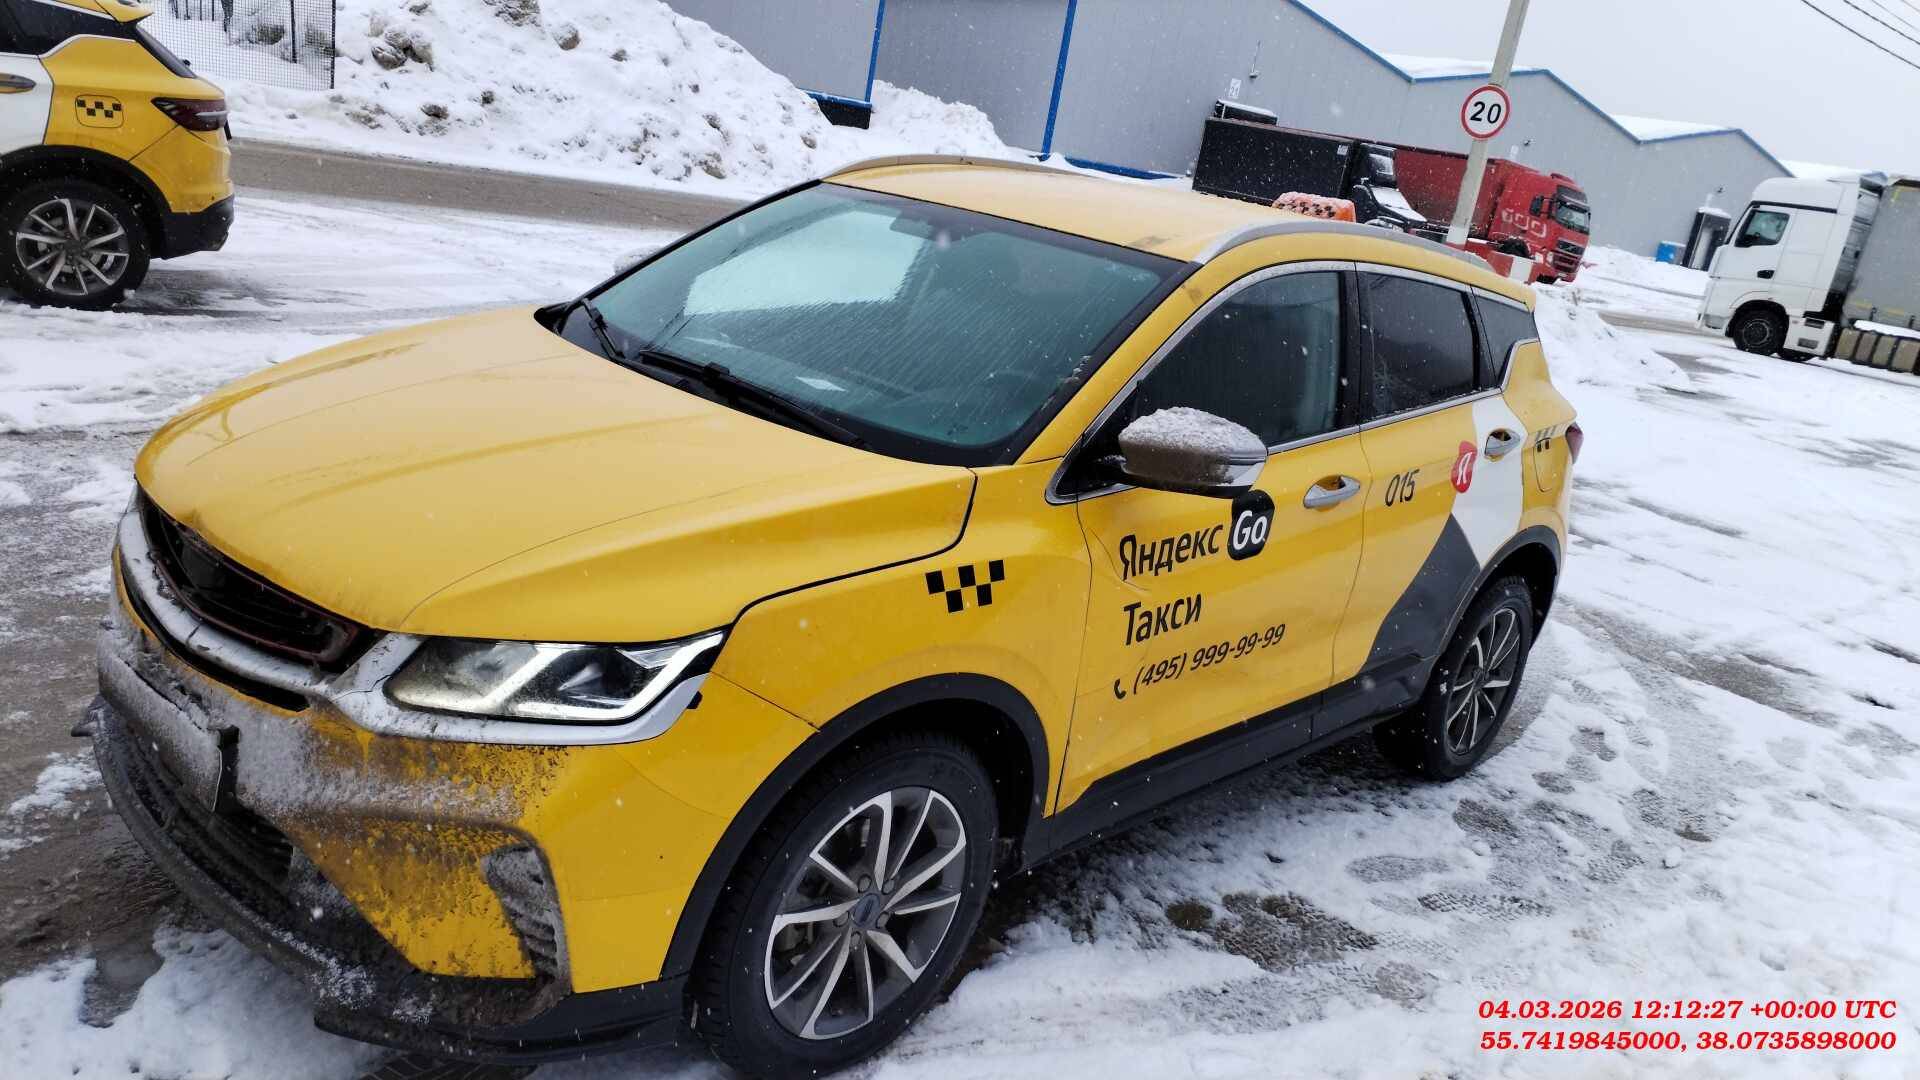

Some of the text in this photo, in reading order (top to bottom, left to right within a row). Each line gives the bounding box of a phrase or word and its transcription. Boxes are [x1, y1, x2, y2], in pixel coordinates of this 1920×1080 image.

[1470, 101, 1502, 124] 20
[1384, 468, 1421, 507] 015
[1119, 510, 1268, 582] Яндекс Go
[1123, 593, 1202, 646] Такси
[1133, 623, 1286, 695] (495) 999-99-99
